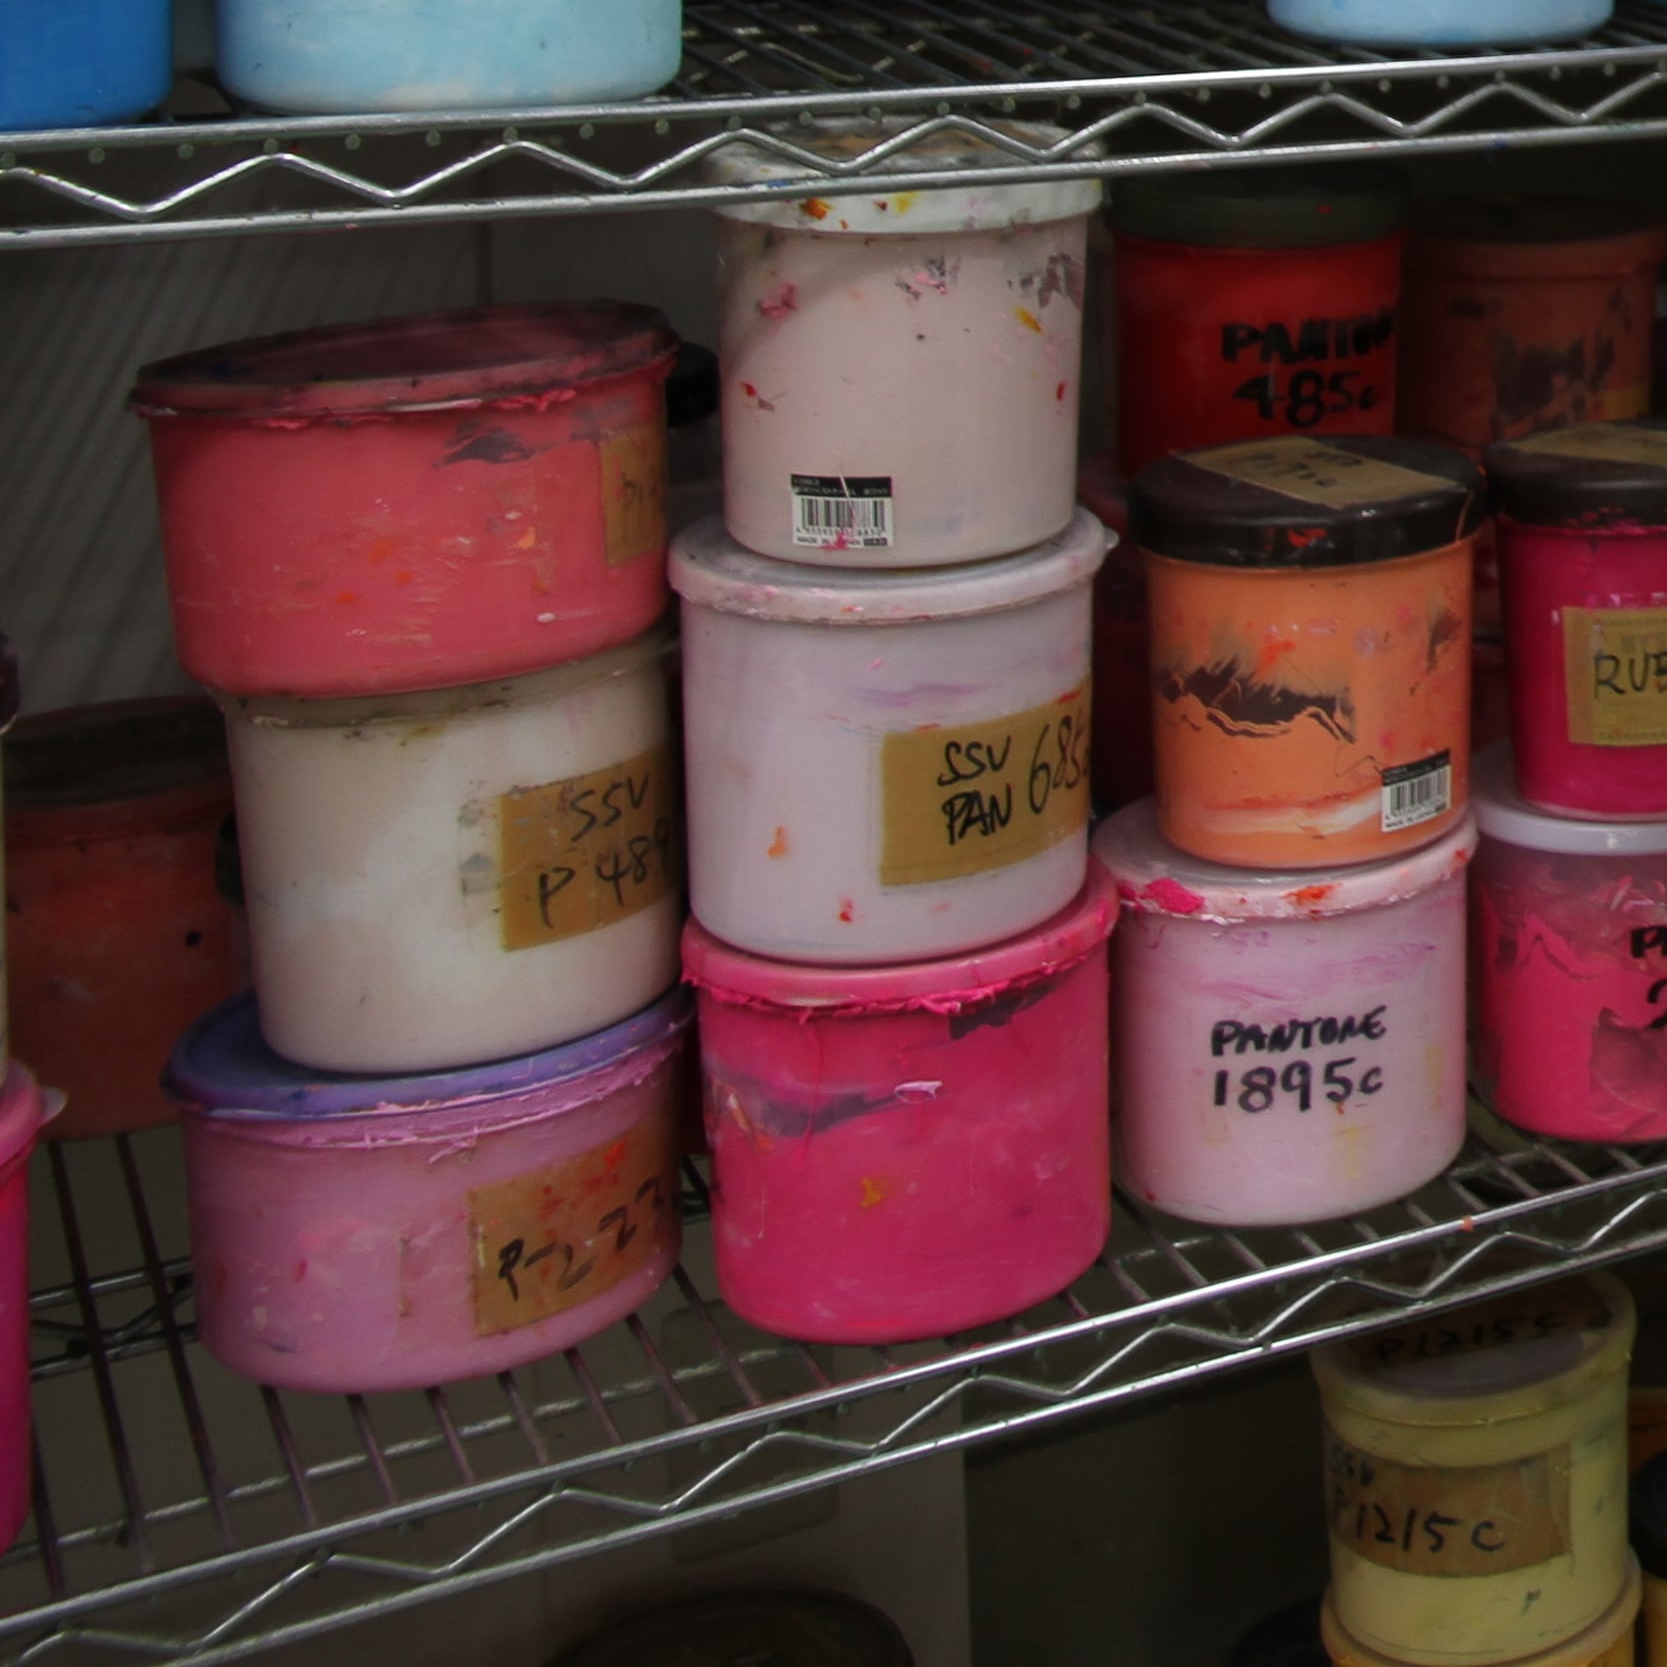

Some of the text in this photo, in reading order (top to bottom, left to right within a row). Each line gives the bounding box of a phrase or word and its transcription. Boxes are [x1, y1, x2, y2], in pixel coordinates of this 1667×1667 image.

[937, 735, 1012, 787] SSV
[570, 773, 649, 843] SSV
[941, 782, 1013, 846] PAN
[1212, 1004, 1388, 1057] PANTONE
[1213, 1056, 1385, 1114] 1895c
